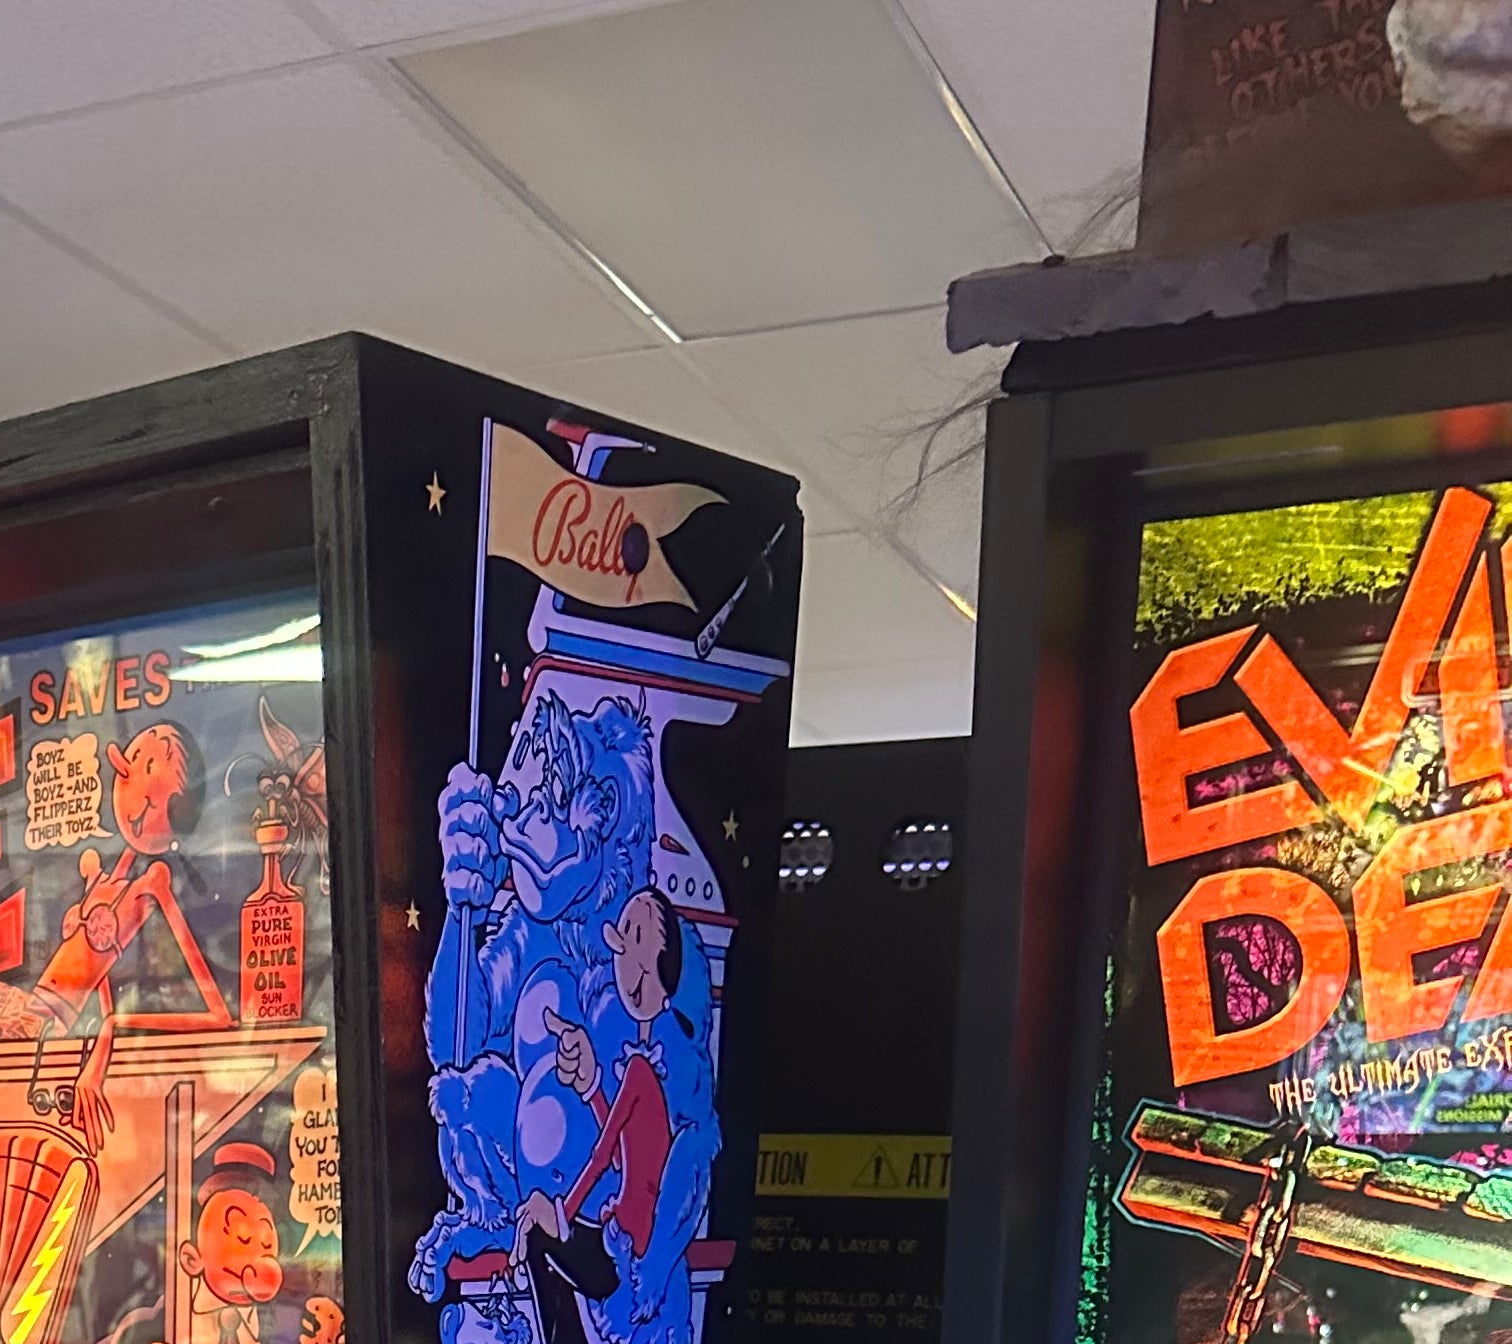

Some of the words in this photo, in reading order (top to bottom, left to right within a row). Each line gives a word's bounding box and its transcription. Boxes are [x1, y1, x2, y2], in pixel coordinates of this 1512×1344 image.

[1129, 486, 1512, 867] EVI
[29, 650, 172, 725] SAVES
[36, 750, 66, 768] BOYZ
[32, 766, 61, 784] WILL
[68, 761, 83, 778] BE
[33, 796, 92, 823] FLIPPERZ
[28, 825, 63, 844] THEIR
[254, 906, 290, 917] EXTRA
[251, 917, 293, 934] PURE
[252, 932, 292, 946] VIRGIN
[246, 947, 297, 968] OLIVE
[254, 970, 286, 992] OIL
[261, 993, 283, 1004] SUN
[245, 1004, 298, 1020] BLOCKER
[1269, 1071, 1317, 1116] THE
[1327, 1047, 1452, 1099] ULTIMATE
[303, 1109, 338, 1129] GLA
[295, 1136, 327, 1157] YOU
[317, 1159, 338, 1178] FO
